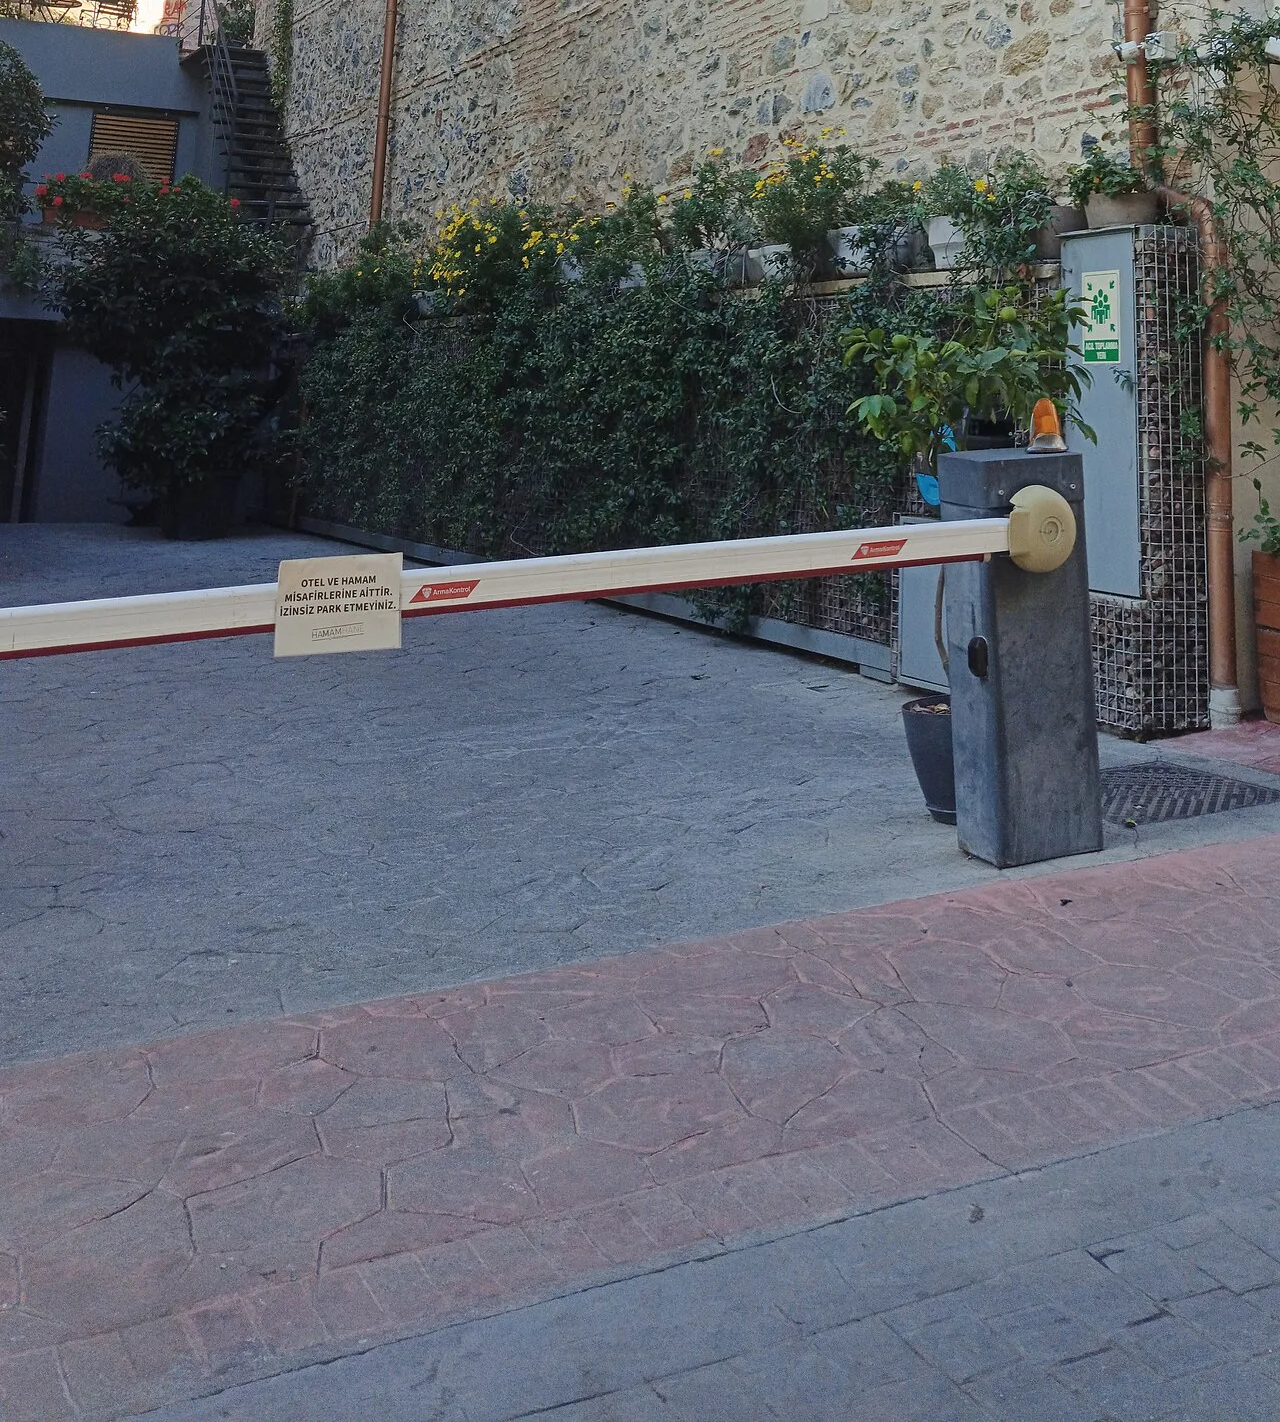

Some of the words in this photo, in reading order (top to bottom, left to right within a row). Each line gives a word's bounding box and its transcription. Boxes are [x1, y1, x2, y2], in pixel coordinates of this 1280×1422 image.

[301, 578, 325, 588] OTEL
[327, 577, 339, 586] VE
[341, 575, 376, 586] HAMAM
[284, 588, 357, 603] MİSAFİRLERİNE
[359, 585, 393, 598] AİTTİR.
[432, 586, 471, 596] ArmaKontrol
[280, 604, 314, 617] İZİNSİZ
[317, 604, 342, 614] PARK
[344, 600, 397, 613] ETMEYİNİZ.
[311, 624, 365, 639] HAMAMHANE
